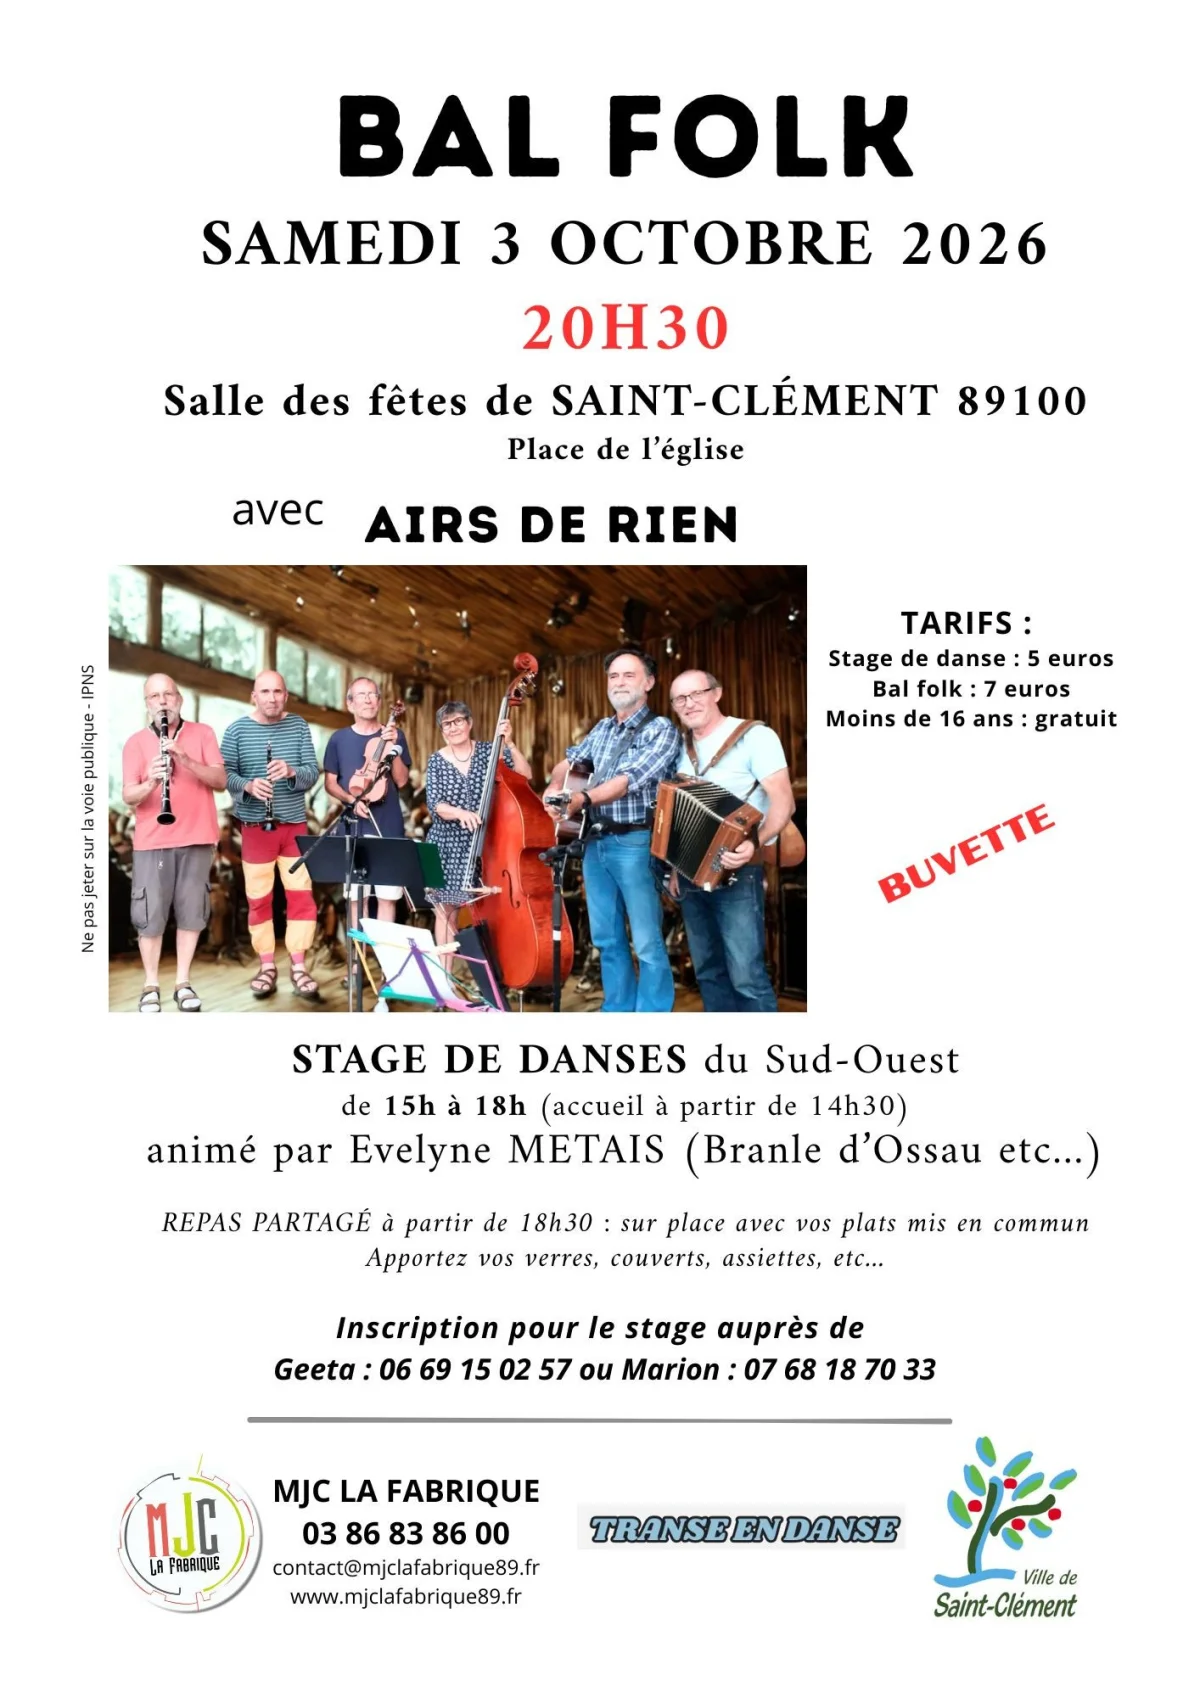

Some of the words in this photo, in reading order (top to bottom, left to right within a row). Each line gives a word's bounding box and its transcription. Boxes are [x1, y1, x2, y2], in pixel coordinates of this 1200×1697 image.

[340, 95, 559, 177] BAL
[610, 94, 914, 178] FOLK
[203, 220, 460, 265] SAMEDI
[492, 222, 519, 264] 3
[551, 220, 872, 265] OCTOBRE
[903, 222, 1046, 265] 2026
[523, 304, 727, 349] 20H30
[165, 384, 263, 416] Salle
[284, 384, 349, 416] des
[369, 383, 466, 416] fêtes
[487, 384, 532, 416] de
[553, 376, 938, 416] SAINT-CLÉMENT
[959, 386, 1085, 416] 89100
[508, 437, 583, 459] Place
[597, 437, 629, 459] de
[233, 500, 323, 526] avec
[365, 506, 498, 543] AIRS
[522, 506, 585, 543] DE
[609, 506, 737, 543] RIEN
[901, 611, 1011, 634] TARIFS
[829, 649, 892, 671] Stage
[902, 649, 928, 667] de
[937, 649, 1005, 667] danse
[1028, 650, 1039, 667] 5
[1049, 654, 1113, 667] euros
[82, 665, 94, 699] IPNS
[874, 680, 907, 697] Bal
[917, 680, 962, 697] folk
[984, 681, 996, 697] 7
[1005, 684, 1070, 697] euros
[827, 710, 895, 727] Moins
[904, 709, 930, 727] de
[941, 710, 964, 727] 16
[974, 714, 1013, 727] ans
[1035, 710, 1117, 732] gratuit
[81, 714, 97, 778] publique
[82, 784, 94, 814] voie
[81, 818, 94, 830] la
[85, 836, 94, 859] sur
[878, 804, 1055, 903] BUVETTE
[82, 864, 98, 898] jeter
[85, 903, 97, 927] pas
[82, 933, 94, 952] Ne
[293, 1044, 426, 1073] STAGE
[445, 1044, 501, 1073] DE
[520, 1044, 685, 1073] DANSES
[705, 1044, 747, 1073] du
[767, 1044, 959, 1073] Sud-Ouest
[342, 1094, 370, 1115] de
[387, 1094, 436, 1115] 15h
[448, 1095, 461, 1115] à
[477, 1094, 526, 1115] 18h
[542, 1094, 643, 1124] (accueil
[656, 1095, 668, 1115] à
[680, 1096, 755, 1122] partir
[769, 1094, 796, 1115] de
[813, 1094, 907, 1124] 14h30)
[148, 1134, 255, 1163] animé
[274, 1144, 332, 1172] par
[351, 1134, 490, 1172] Evelyne
[509, 1134, 664, 1163] METAIS
[687, 1132, 820, 1175] (Branle
[162, 1212, 241, 1232] REPAS
[253, 1208, 371, 1232] PARTAGÉ
[383, 1213, 394, 1232] à
[405, 1213, 473, 1238] partir
[484, 1212, 507, 1232] de
[522, 1212, 592, 1232] 18h30
[621, 1219, 657, 1231] sur
[666, 1212, 724, 1238] place
[736, 1219, 784, 1231] avec
[797, 1219, 831, 1231] vos
[841, 1212, 896, 1238] plats
[908, 1213, 946, 1231] mis
[958, 1219, 981, 1231] en
[994, 1219, 1088, 1231] commun
[365, 1248, 467, 1273] Apportez
[480, 1254, 513, 1267] vos
[526, 1254, 597, 1270] verres,
[611, 1251, 709, 1270] couverts,
[723, 1248, 820, 1270] assiettes,
[337, 1316, 497, 1345] Inscription
[508, 1322, 579, 1345] pour
[589, 1316, 614, 1338] le
[625, 1319, 706, 1345] stage
[718, 1316, 818, 1345] auprès
[830, 1316, 863, 1338] de
[275, 1358, 355, 1380] Geeta
[380, 1358, 412, 1380] 06
[420, 1358, 451, 1380] 69
[462, 1358, 491, 1380] 15
[500, 1358, 531, 1380] 02
[539, 1358, 572, 1380] 57
[580, 1363, 613, 1380] ou
[622, 1357, 719, 1380] Marion
[745, 1358, 777, 1380] 07
[785, 1358, 816, 1380] 68
[827, 1358, 856, 1380] 18
[865, 1358, 896, 1380] 70
[903, 1358, 936, 1380] 33
[274, 1479, 330, 1508] MJC
[341, 1480, 378, 1503] LA
[388, 1479, 539, 1508] FABRIQUE
[146, 1492, 219, 1558] MJC
[303, 1522, 336, 1545] 03
[346, 1522, 380, 1545] 86
[389, 1522, 423, 1545] 83
[433, 1522, 466, 1545] 86
[476, 1522, 509, 1545] 00
[590, 1515, 731, 1542] TRANSE
[730, 1515, 783, 1542] EN
[782, 1515, 901, 1542] DANSE
[150, 1559, 164, 1576] LA
[169, 1556, 220, 1575] FABRIQUE
[273, 1558, 540, 1580] contact@mjclafabrique89.fr
[1024, 1569, 1054, 1585] Ville
[1059, 1569, 1078, 1585] de
[291, 1588, 522, 1609] www.mjclafabrique89.fr
[933, 1591, 1078, 1618] Saint-Clément
